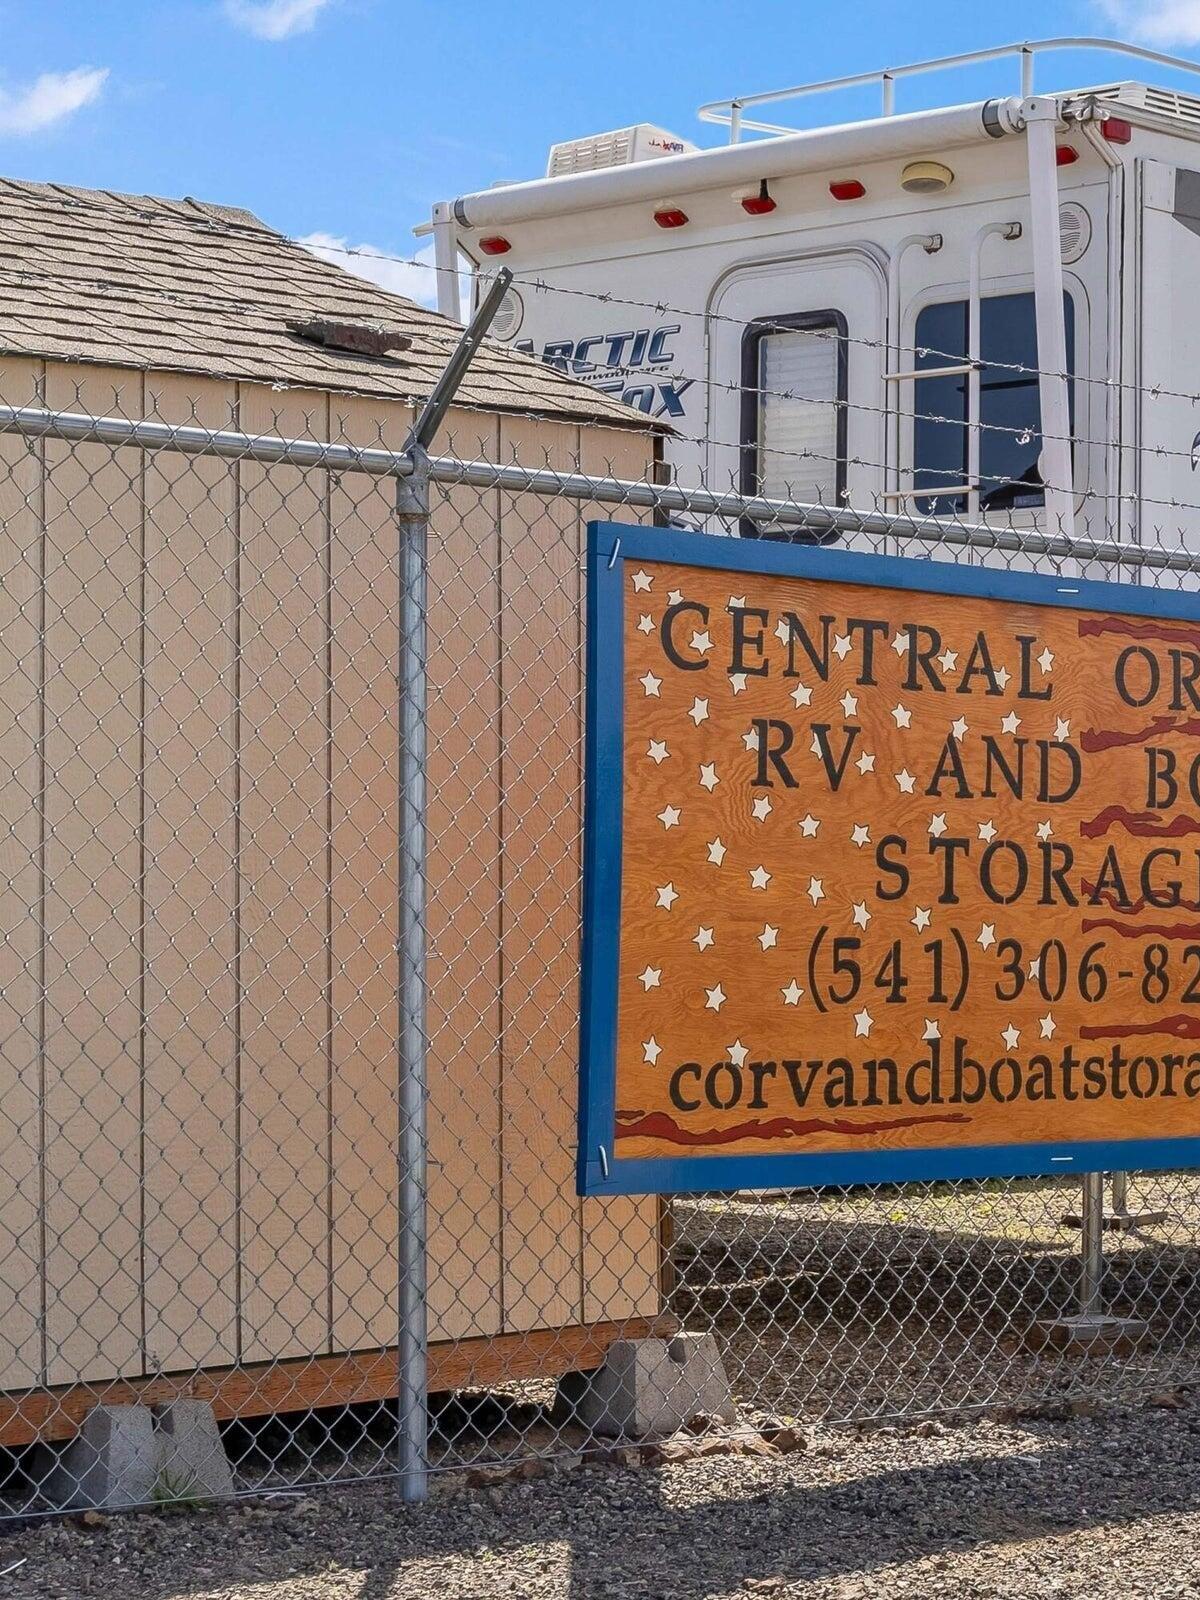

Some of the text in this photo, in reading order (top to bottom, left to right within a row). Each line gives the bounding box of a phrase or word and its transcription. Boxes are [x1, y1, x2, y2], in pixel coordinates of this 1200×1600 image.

[660, 600, 1054, 701] CENTRAL
[750, 719, 863, 792] RV
[924, 732, 1083, 803] AND
[806, 924, 971, 1012] (541)
